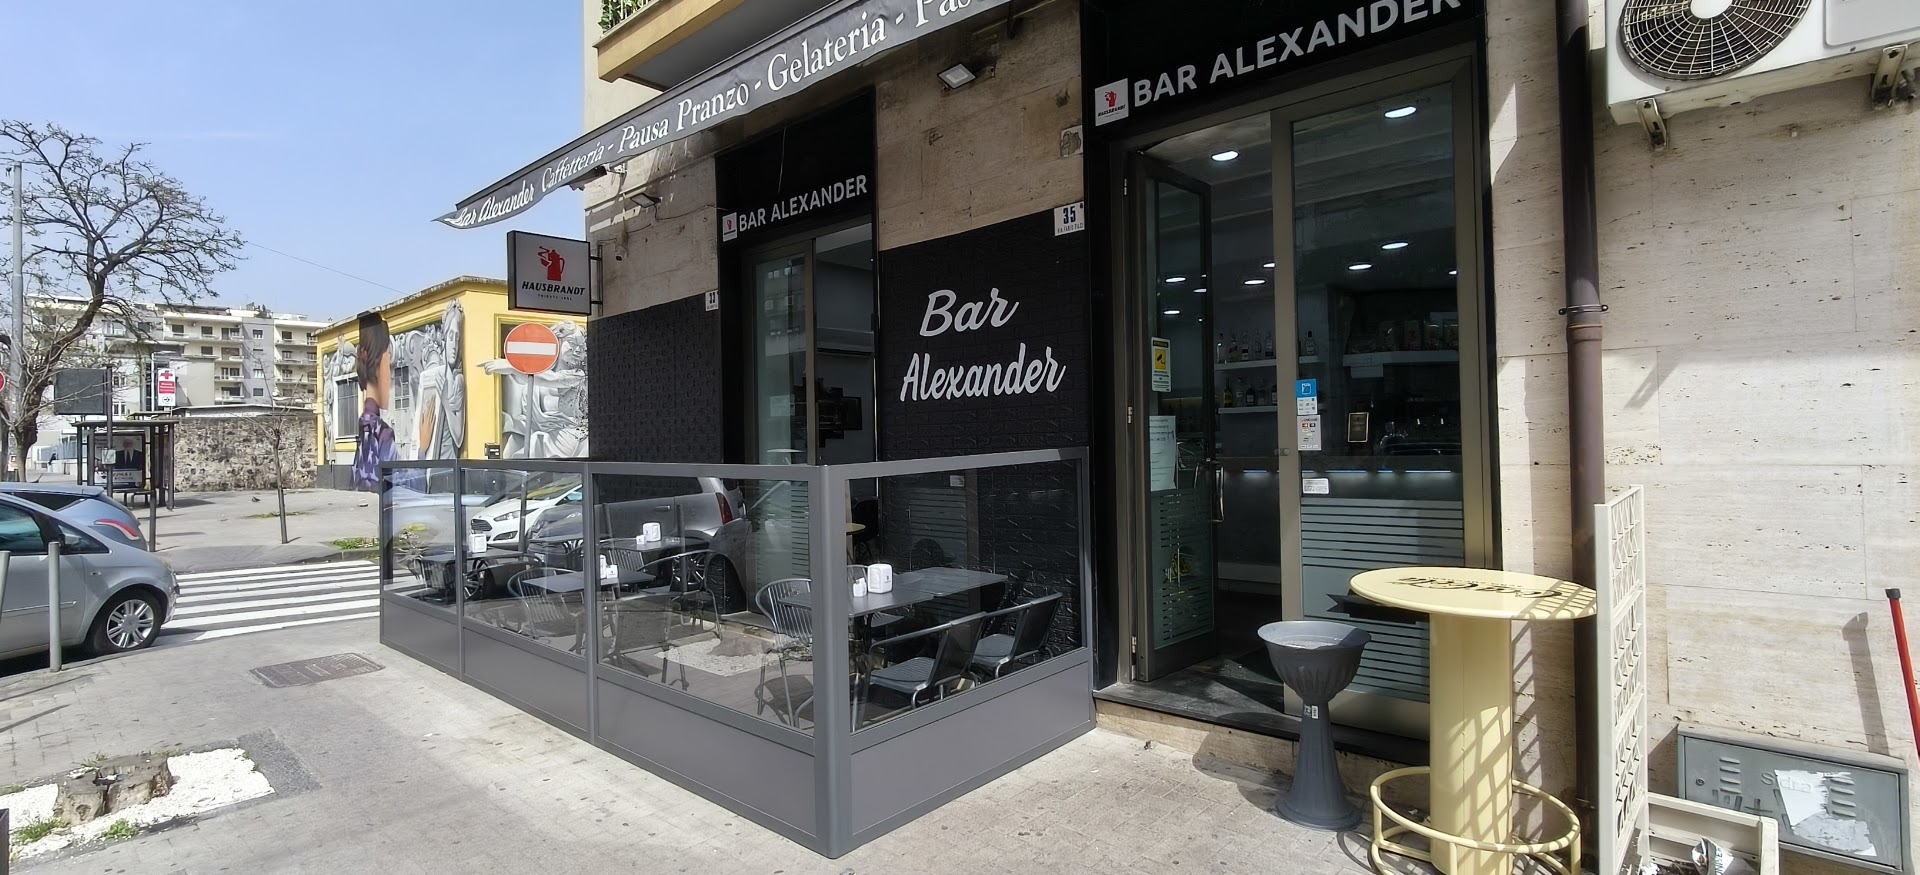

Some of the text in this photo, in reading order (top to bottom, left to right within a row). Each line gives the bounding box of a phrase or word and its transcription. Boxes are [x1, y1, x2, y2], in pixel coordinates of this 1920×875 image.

[1134, 64, 1197, 107] BAR
[443, 207, 477, 227] Bar
[478, 180, 535, 223] Alexander
[541, 142, 605, 193] Caffetteria
[617, 118, 669, 154] Pausa
[675, 82, 749, 132] Pranzo
[767, 11, 887, 92] Gelateria
[739, 174, 868, 232] BAR ALEXANDER
[1063, 206, 1076, 224] 35
[521, 281, 585, 296] HAUSBRANDT
[709, 291, 716, 304] 33
[919, 287, 1020, 337] Bar
[900, 342, 1067, 402] Alexander
